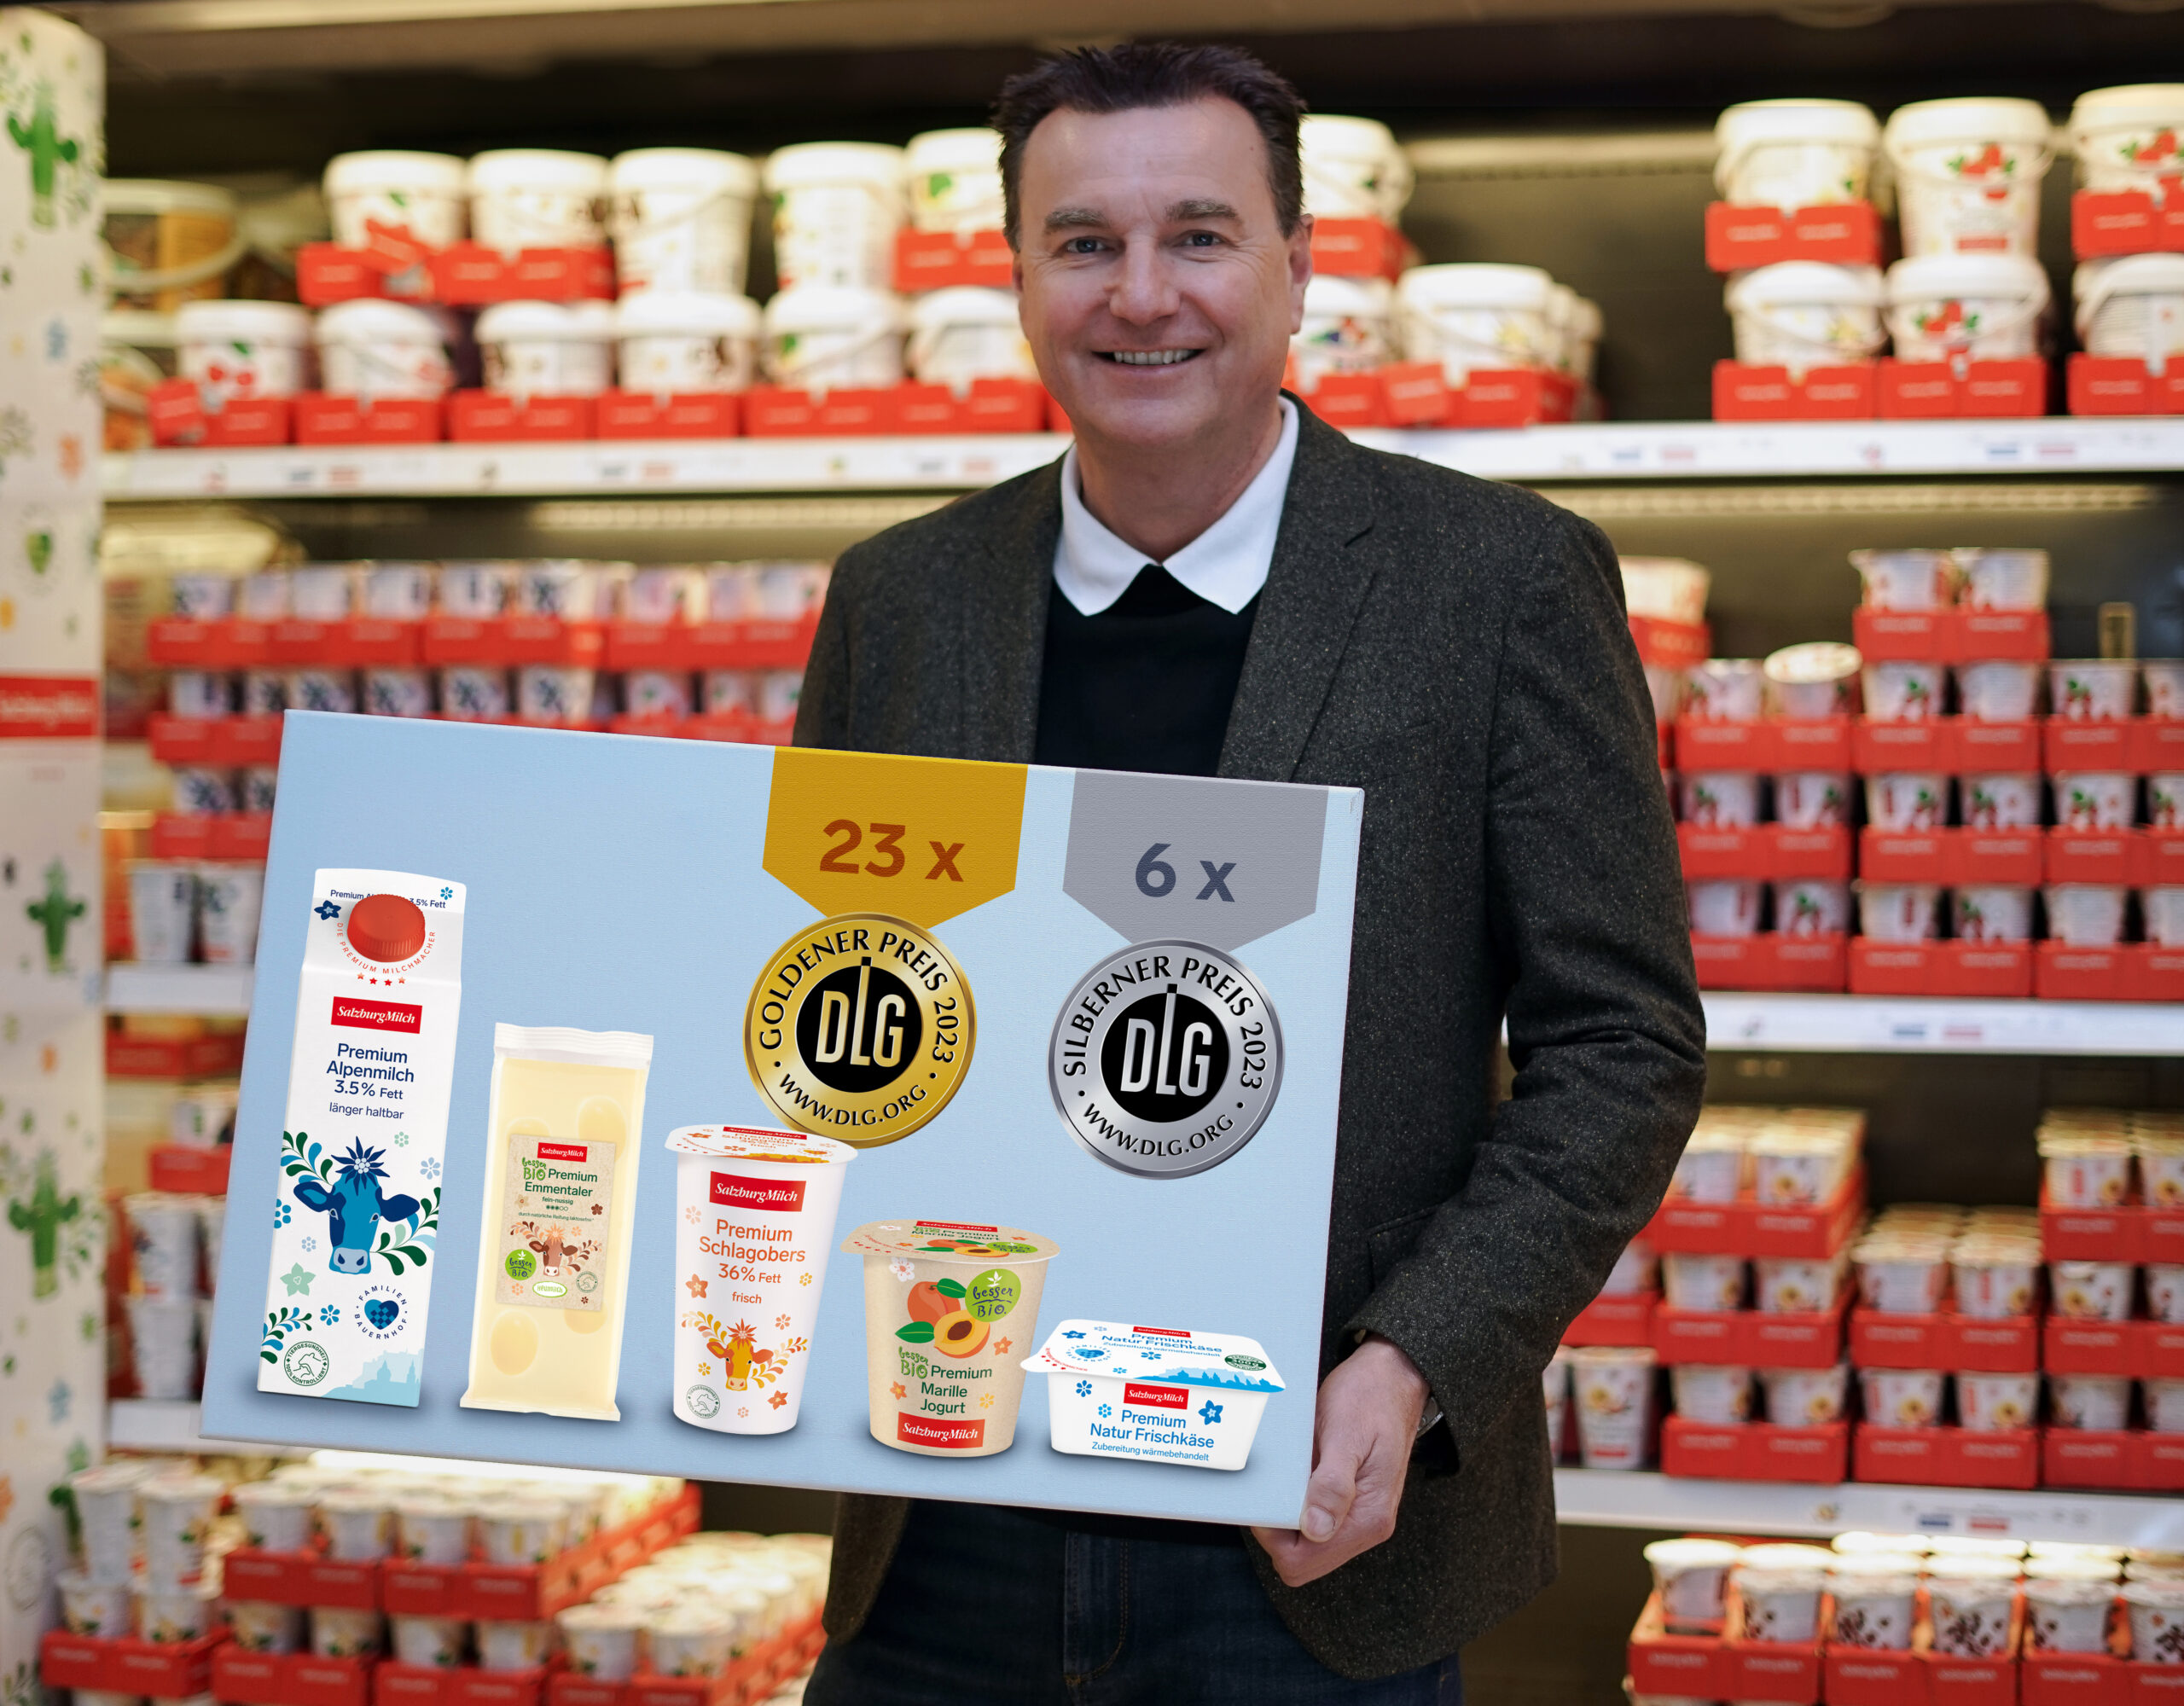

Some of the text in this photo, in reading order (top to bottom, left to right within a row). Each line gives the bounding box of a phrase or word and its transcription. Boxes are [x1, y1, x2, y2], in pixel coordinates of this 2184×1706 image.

[820, 819, 965, 882] 23 x
[1135, 843, 1237, 902] 6 x
[330, 889, 364, 901] Premium
[430, 900, 446, 908] Fett
[340, 941, 377, 972] PREMIUM
[382, 931, 436, 973] MILCHMACHER
[760, 929, 960, 1064] GOLDENER PREIS 2023
[816, 956, 906, 1068] DLG
[1063, 955, 1268, 1090] SILBERNER PREIS 2023
[1120, 983, 1212, 1097] DLG
[337, 1042, 408, 1064] Premium
[326, 1060, 415, 1082] Alpenmilch
[334, 1079, 404, 1100] 3.5% Fett
[780, 1073, 927, 1126] WWW.DLG.ORG
[328, 1102, 404, 1119] länger haltbar
[1083, 1101, 1234, 1157] WWW.DLG.ORG
[549, 1169, 598, 1182] Premium
[525, 1181, 593, 1197] Emmentaler
[542, 1196, 573, 1205] fein-nussig
[717, 1218, 793, 1241] Premium
[699, 1236, 806, 1263] Schlagobers
[718, 1262, 781, 1284] 36% Fett
[358, 1285, 407, 1305] FAMILIEN
[732, 1291, 762, 1303] frisch
[973, 1285, 1013, 1300] besser
[354, 1314, 407, 1340] BAUERNHOF
[1101, 1335, 1223, 1353] Natur Frischkäse
[1131, 1333, 1193, 1344] Premium
[287, 1343, 328, 1361] TIERGESUNDHEIT
[292, 1367, 327, 1384] KONTROLLIERT
[931, 1365, 992, 1379] Premium
[921, 1382, 967, 1397] Marille
[920, 1399, 966, 1415] Jogurt
[1121, 1409, 1186, 1429] Premium
[1089, 1423, 1214, 1448] Natur Frischkäse
[1091, 1442, 1210, 1461] Zubereitung wärmebehandelt
